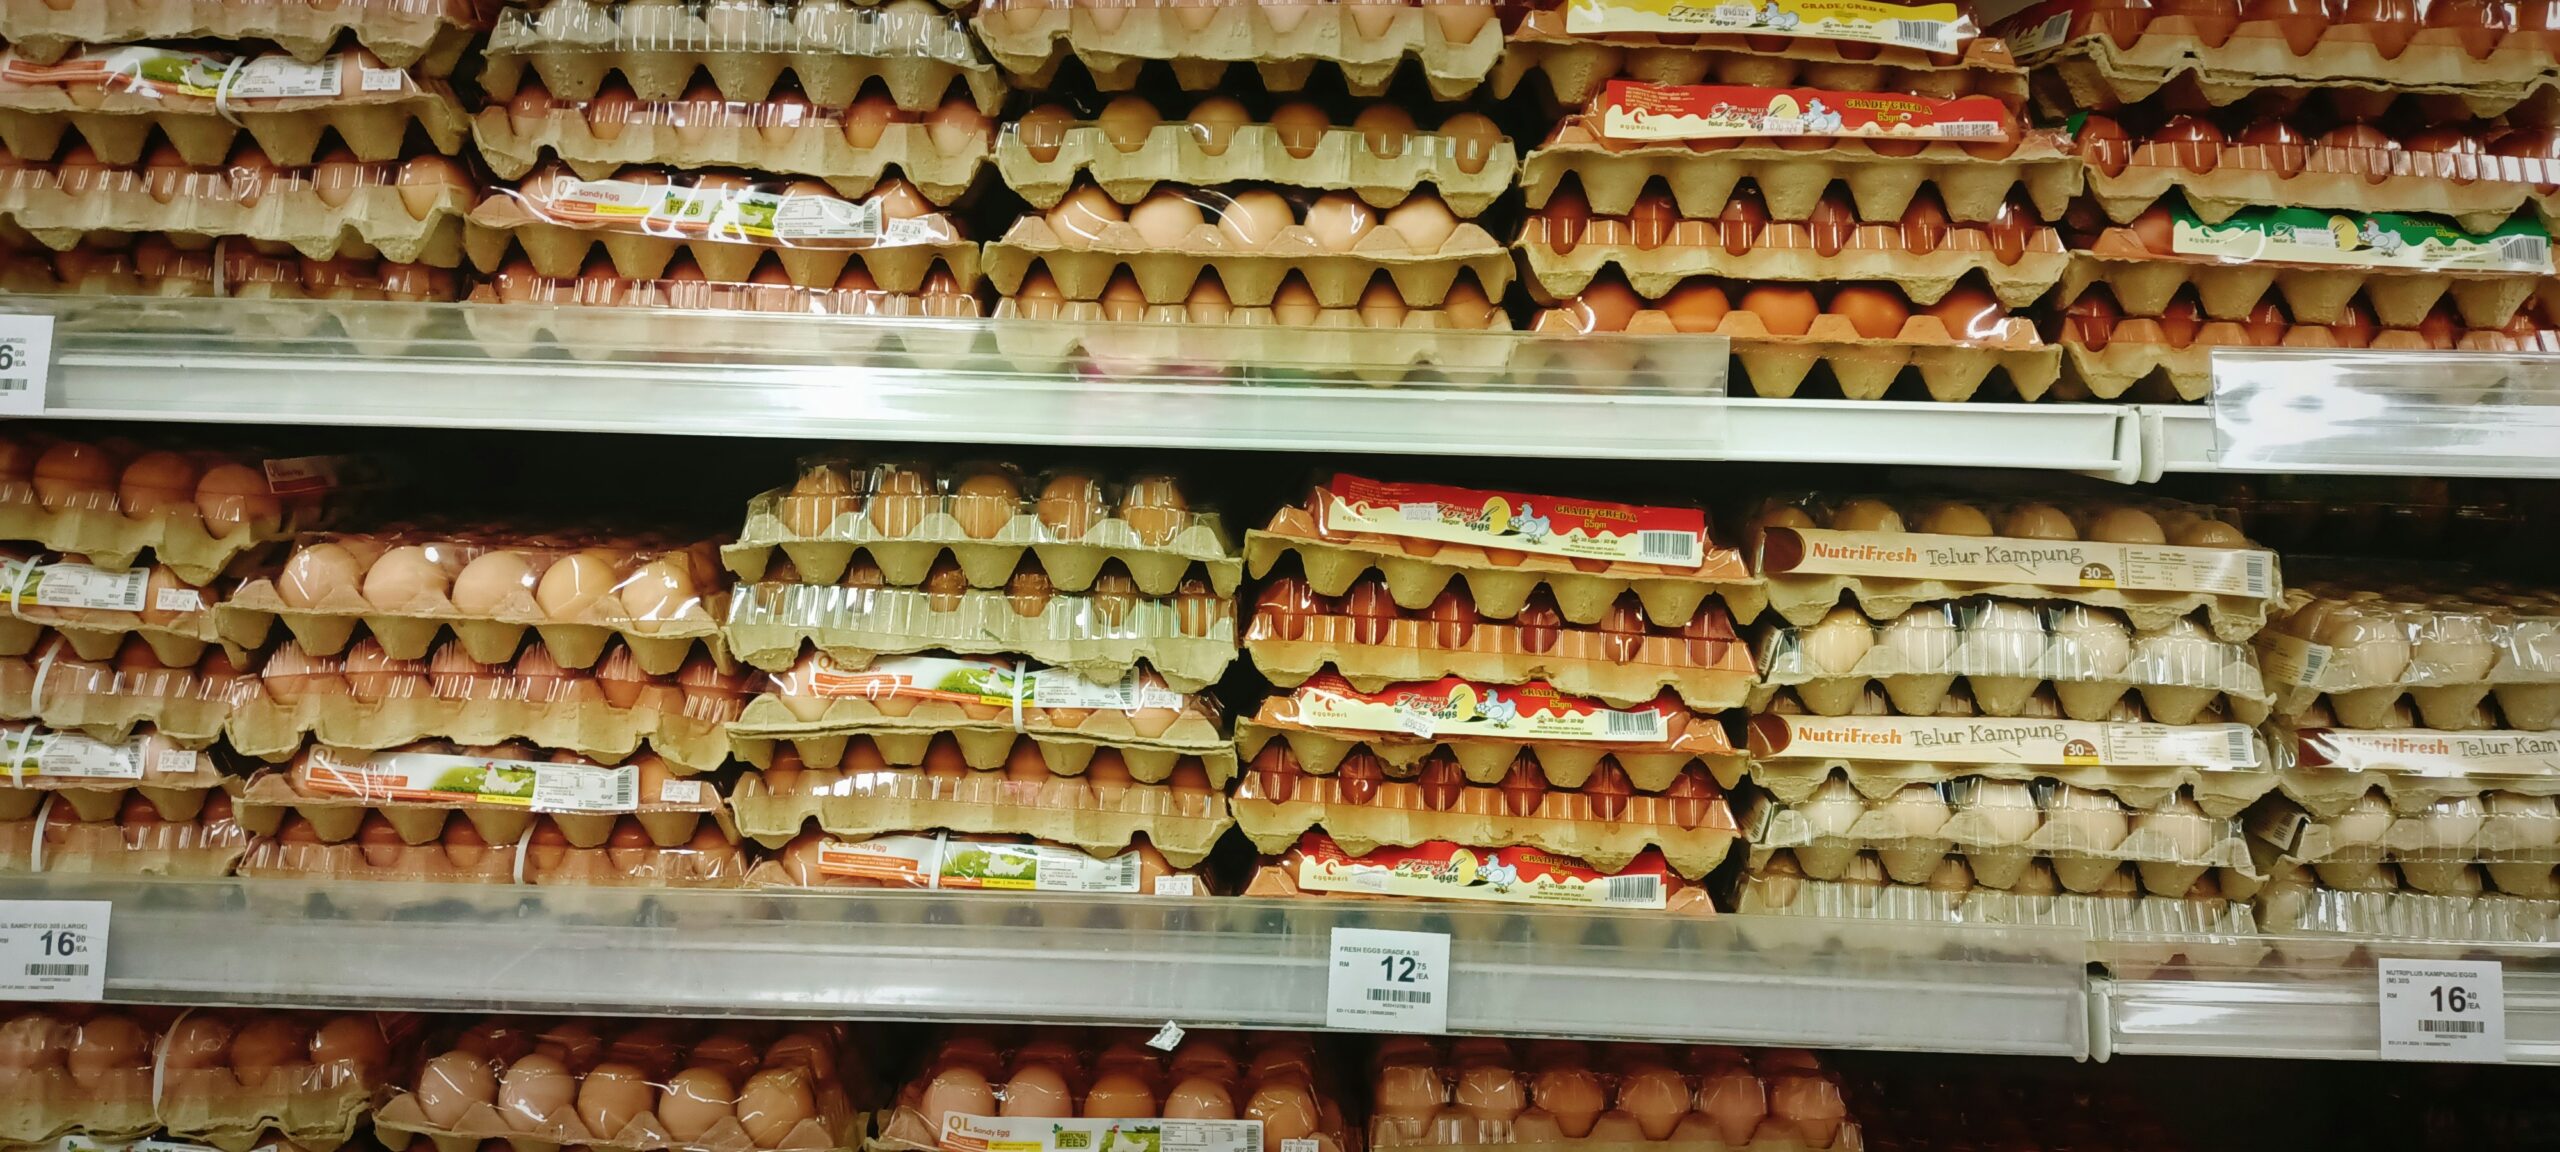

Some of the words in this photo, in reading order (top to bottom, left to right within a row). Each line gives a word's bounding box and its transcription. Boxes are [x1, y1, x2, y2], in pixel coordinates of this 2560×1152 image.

[1845, 100, 1923, 114] GRADE/GRED
[1923, 106, 1933, 115] A
[1725, 121, 1745, 129] Segar
[579, 190, 603, 201] Sandy
[604, 191, 620, 201] Egg
[1555, 504, 1629, 520] GRADE/GRED
[1629, 514, 1638, 522] A
[1441, 518, 1460, 526] Segar
[1465, 521, 1490, 531] eggs
[1584, 519, 1607, 530] 65gm
[1812, 543, 1917, 563] NutriFresh
[1926, 548, 1980, 566] Telur
[1985, 546, 2084, 567] Kampung
[2084, 567, 2101, 579] 30
[1395, 692, 1465, 711] Fresh
[1550, 700, 1572, 710] 65gm
[1432, 710, 1457, 719] eggs
[1798, 727, 1902, 745] NutriFresh
[1911, 730, 1965, 747] Telur
[1968, 724, 2068, 746] Kampung
[2067, 744, 2084, 756] 30
[2457, 740, 2510, 758] Telur
[341, 760, 365, 770] Sandy
[872, 844, 886, 853] Egg
[1396, 858, 1466, 874] Fresh
[1433, 874, 1458, 884] eggs
[40, 930, 75, 957] 16
[1381, 956, 1415, 983] 12
[2430, 986, 2466, 1012] 16
[948, 1116, 972, 1133] QL
[973, 1126, 996, 1137] Sandy
[997, 1127, 1010, 1138] Egg
[1059, 1139, 1087, 1148] FEED
